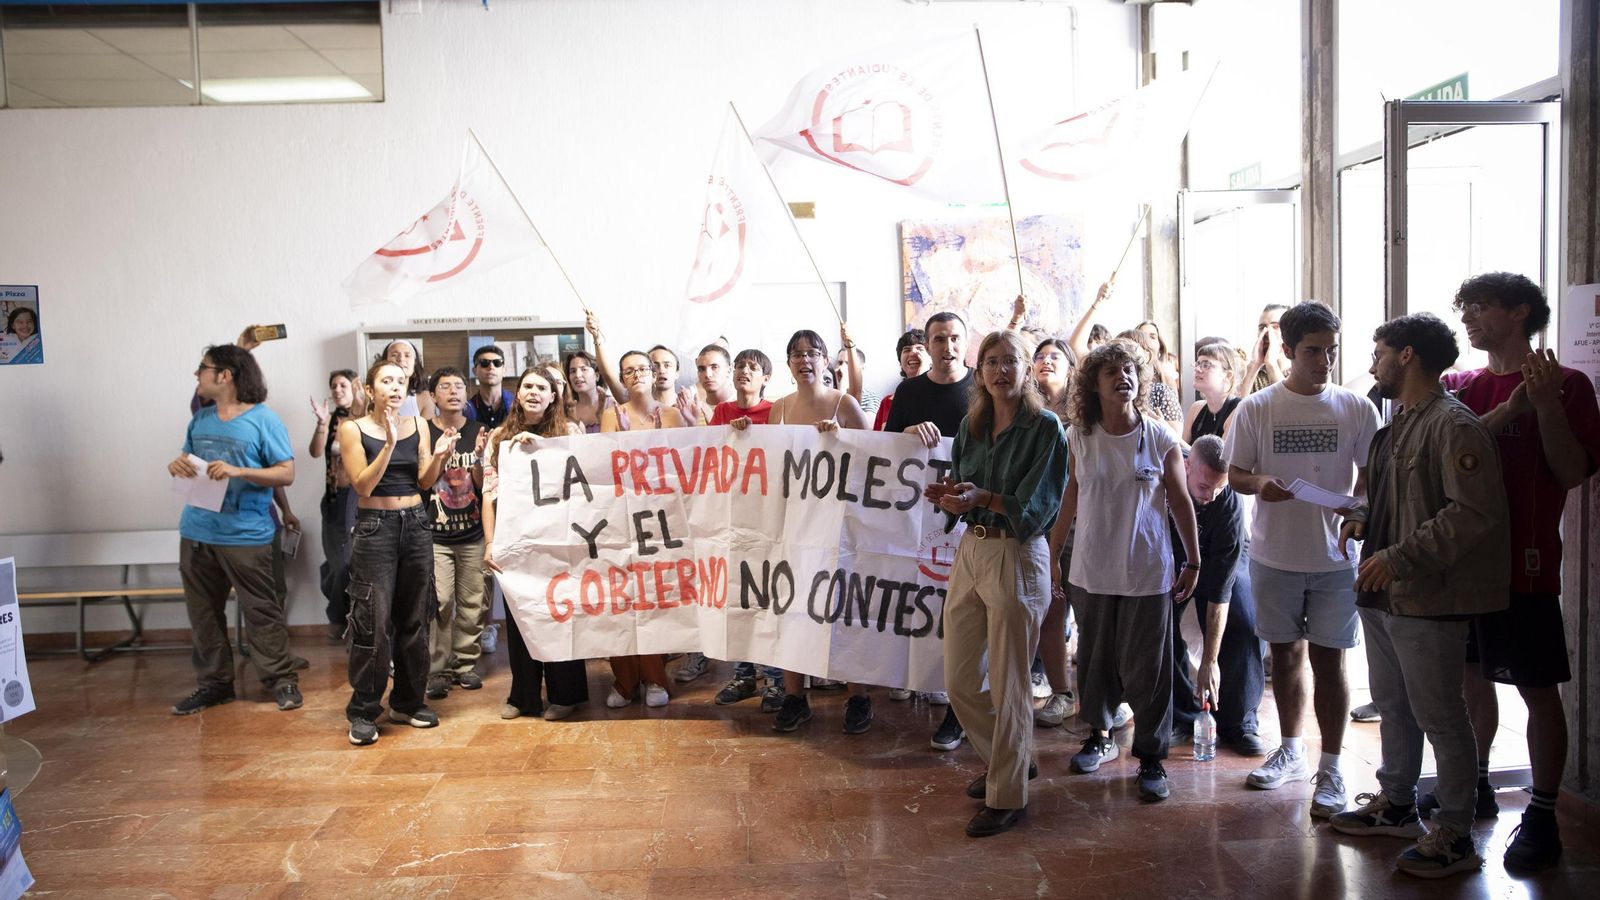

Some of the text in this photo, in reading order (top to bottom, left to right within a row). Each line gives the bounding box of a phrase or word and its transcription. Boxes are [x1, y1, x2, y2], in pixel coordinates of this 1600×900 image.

[531, 455, 594, 506] LA
[611, 446, 768, 498] PRIVADA
[783, 448, 952, 514] MOLEST
[571, 508, 684, 559] Y EL
[545, 556, 948, 640] GOBIERNO NO CONTEST
